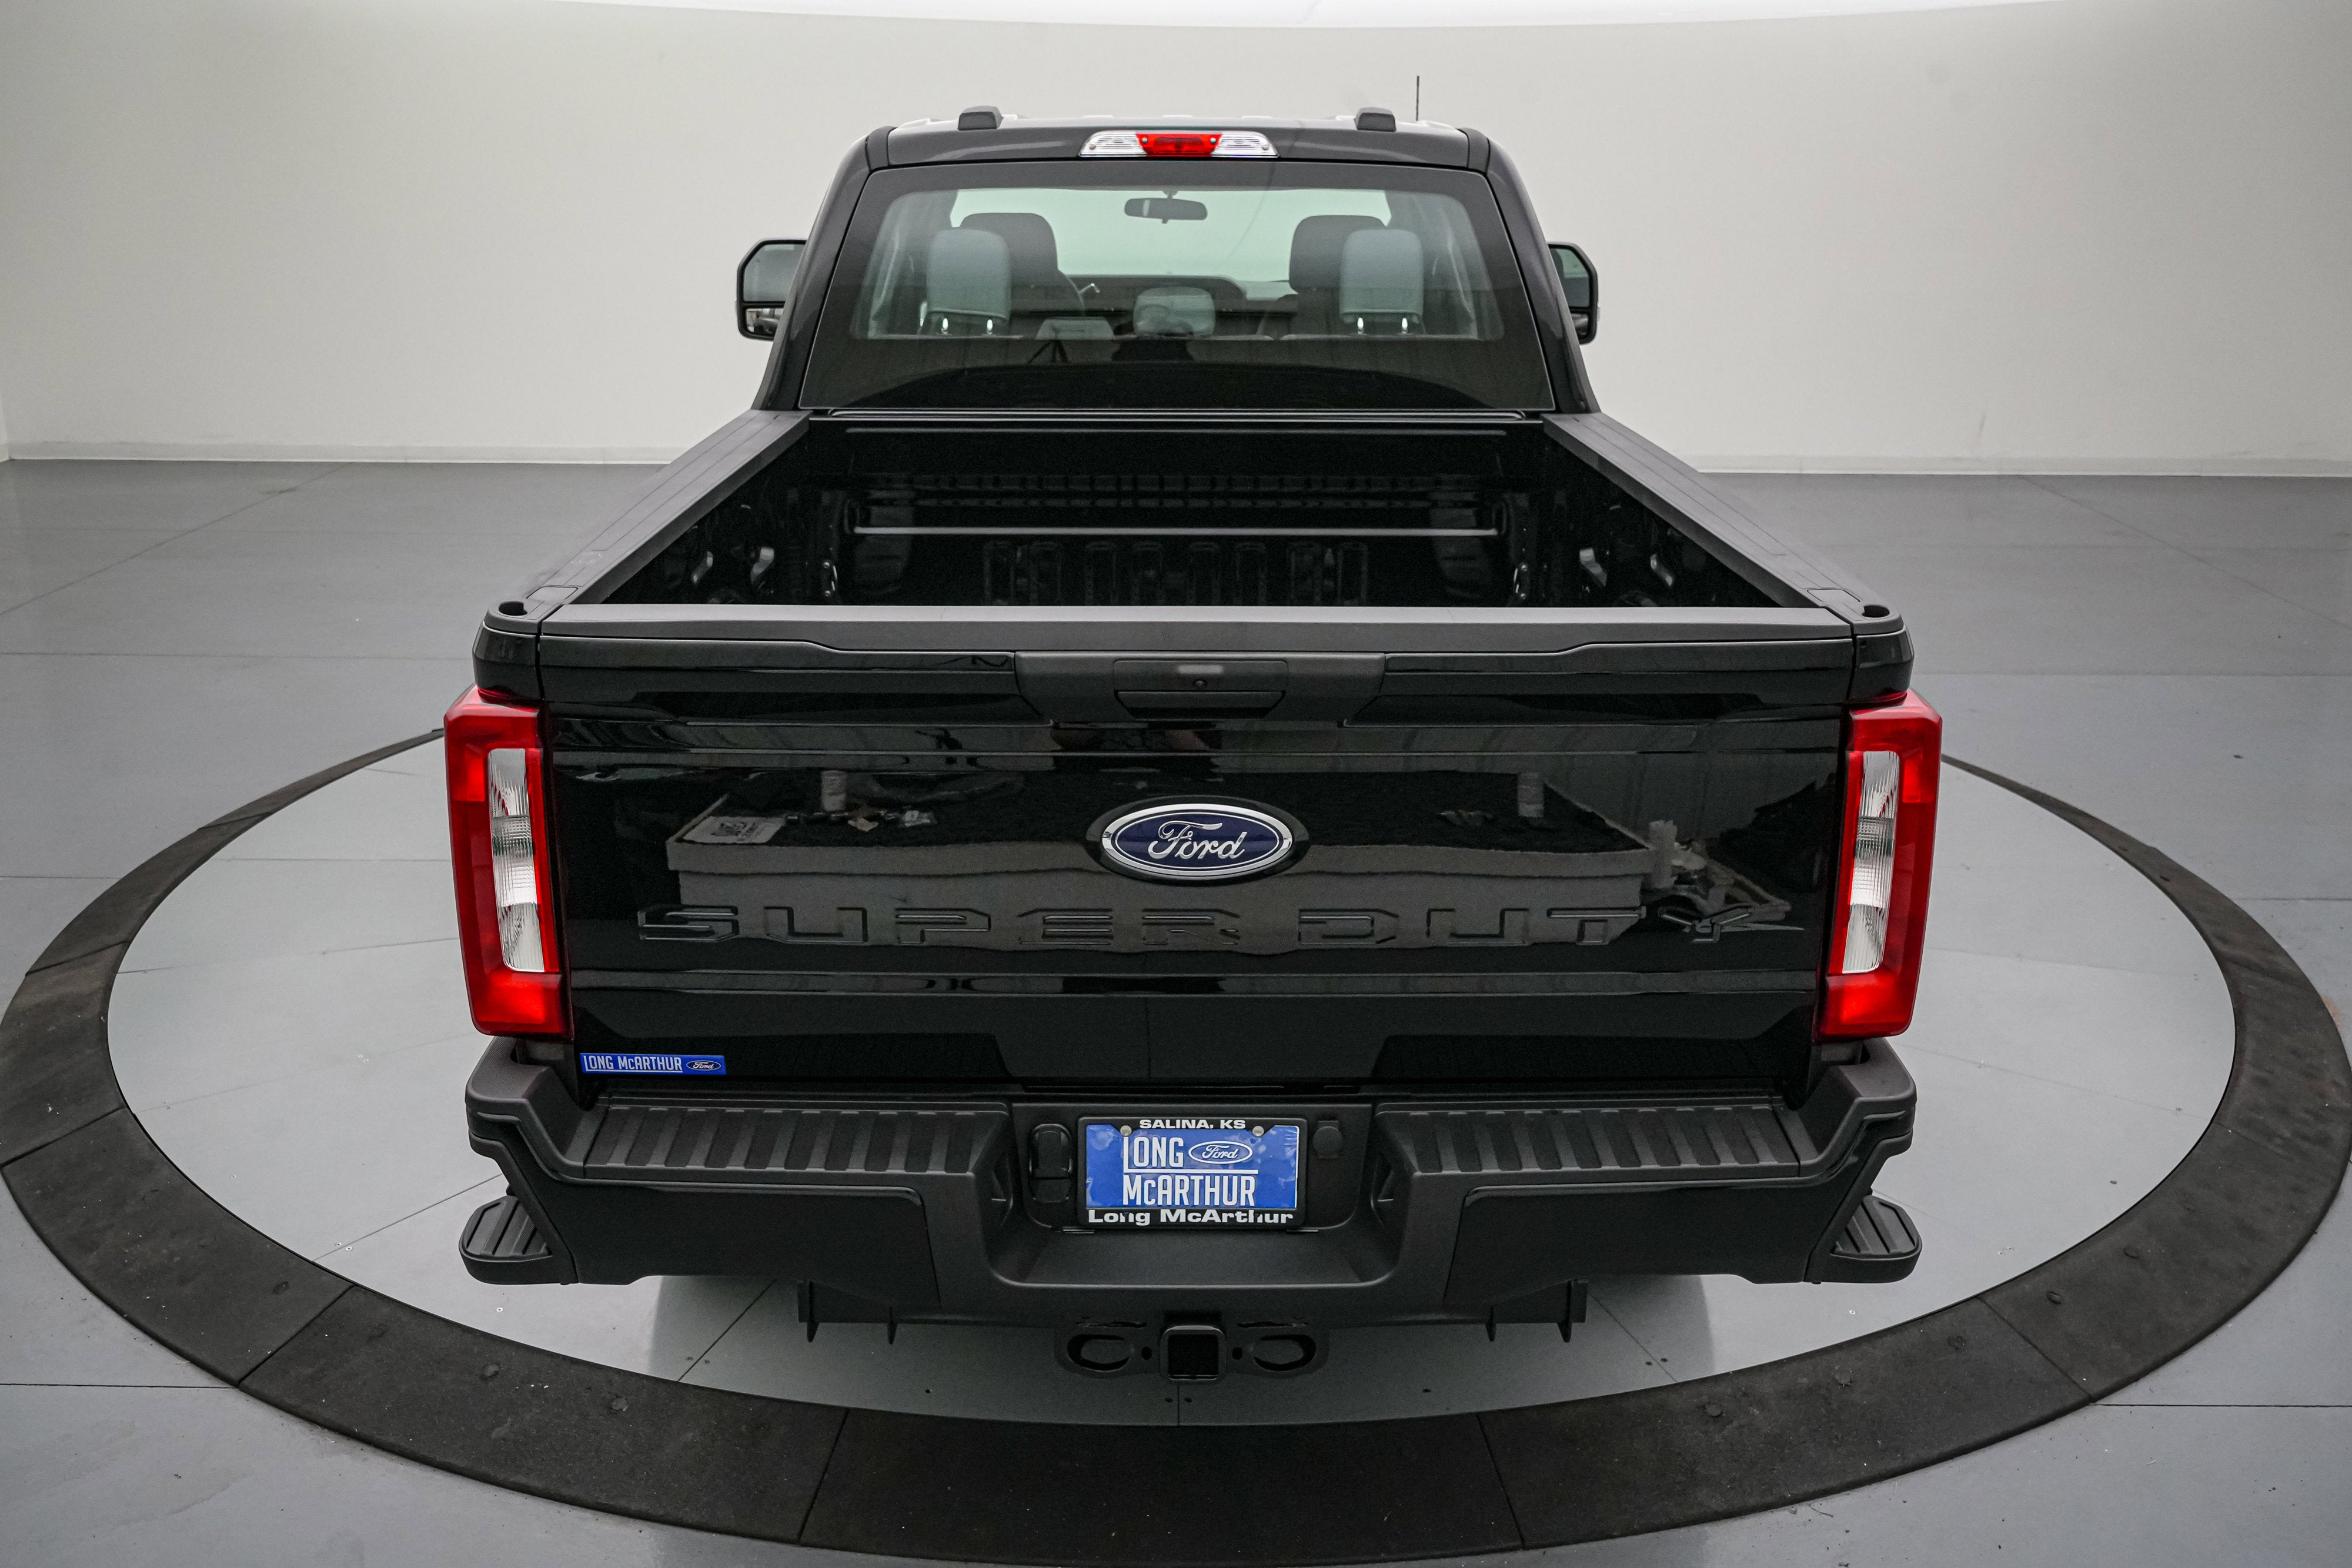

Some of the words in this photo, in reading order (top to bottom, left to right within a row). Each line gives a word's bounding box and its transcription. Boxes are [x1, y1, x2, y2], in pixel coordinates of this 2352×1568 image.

[1148, 820, 1247, 860] Ford
[637, 904, 1241, 947] SUPER
[1298, 904, 1753, 944] DUTY
[583, 1055, 614, 1071] LONG
[617, 1056, 683, 1071] McARTHUR
[693, 1061, 714, 1070] Ford
[1139, 1119, 1214, 1129] SALINA,
[1220, 1119, 1246, 1129] KS
[1123, 1136, 1184, 1174] LONG
[1202, 1144, 1238, 1160] Ford
[1122, 1175, 1256, 1206] McARTHUR
[1088, 1209, 1150, 1226] Long
[1160, 1209, 1294, 1224] McArthur
